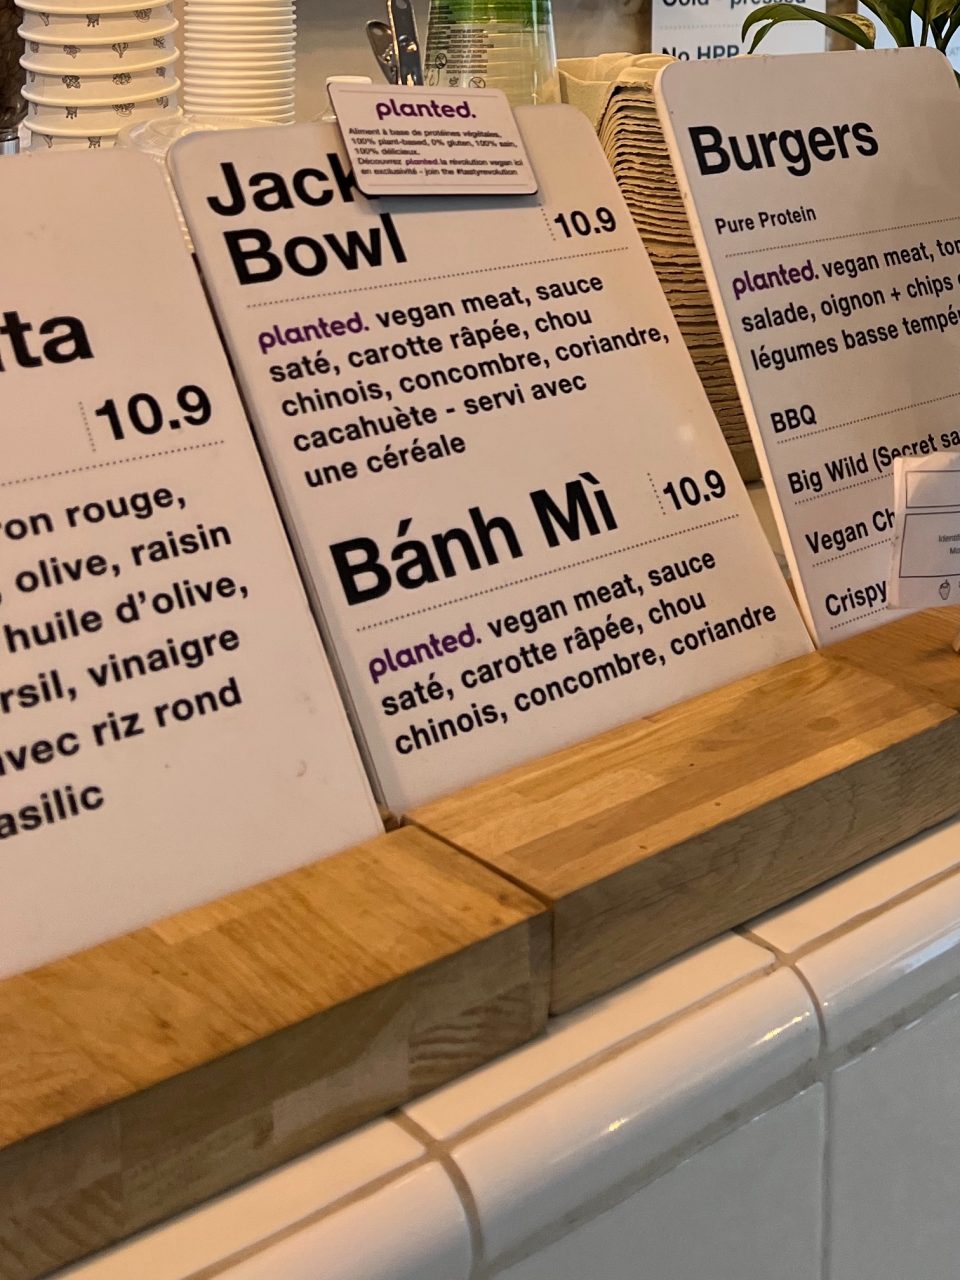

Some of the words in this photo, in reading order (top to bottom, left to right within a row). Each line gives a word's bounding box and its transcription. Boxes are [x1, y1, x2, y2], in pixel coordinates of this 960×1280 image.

[662, 45, 689, 61] No
[376, 98, 477, 120] planted.
[688, 121, 879, 177] Burgers
[223, 211, 408, 287] Bowl
[554, 204, 618, 241] 10.9
[714, 215, 755, 236] Pure
[758, 205, 817, 229] Protein
[731, 259, 820, 300] planted.
[821, 252, 880, 279] vegan
[883, 242, 936, 269] meat,
[257, 311, 370, 355] planted.
[375, 298, 456, 332] vegan
[461, 285, 533, 315] meat,
[535, 273, 605, 303] sauce
[741, 304, 817, 333] salade,
[820, 286, 885, 318] oignon
[890, 286, 901, 302] +
[906, 272, 954, 301] chips
[0, 311, 95, 371] ta
[269, 351, 341, 385] saté,
[347, 334, 444, 370] carotte
[450, 317, 530, 357] râpée,
[534, 304, 593, 335] chou
[750, 335, 839, 371] légumes
[842, 322, 900, 352] basse
[281, 379, 394, 419] chinois,
[399, 348, 551, 395] concombre,
[555, 325, 670, 362] coriandre,
[95, 384, 212, 441] 10.9
[293, 404, 438, 453] cacahuète
[465, 387, 526, 417] servi
[531, 373, 588, 401] avec
[770, 404, 818, 434] BBQ
[304, 460, 359, 489] une
[367, 432, 467, 475] céréale
[787, 469, 824, 496] Big
[825, 450, 870, 483] Wild
[872, 432, 939, 474] (Secret
[0, 512, 54, 541] on
[65, 487, 187, 528] rouge,
[662, 468, 727, 512] 10.9
[15, 553, 121, 593] olive,
[131, 523, 232, 567] raisin
[329, 505, 525, 607] Bánh
[529, 470, 619, 549] Mì
[805, 518, 870, 556] Vegan
[368, 622, 483, 684] planted.
[487, 598, 569, 640] vegan
[573, 573, 645, 614] meat,
[648, 550, 717, 588] sauce
[824, 580, 888, 617] Crispy
[4, 608, 103, 654] huile
[87, 629, 241, 688] vinaigre
[381, 671, 455, 717] saté,
[460, 637, 558, 691] carotte
[563, 614, 644, 658] râpée,
[648, 590, 707, 626] chou
[394, 702, 509, 755] chinois,
[513, 646, 667, 713] concombre,
[670, 602, 777, 657] coriandre
[0, 731, 80, 777] vec
[92, 711, 145, 747] riz
[154, 677, 243, 728] rond
